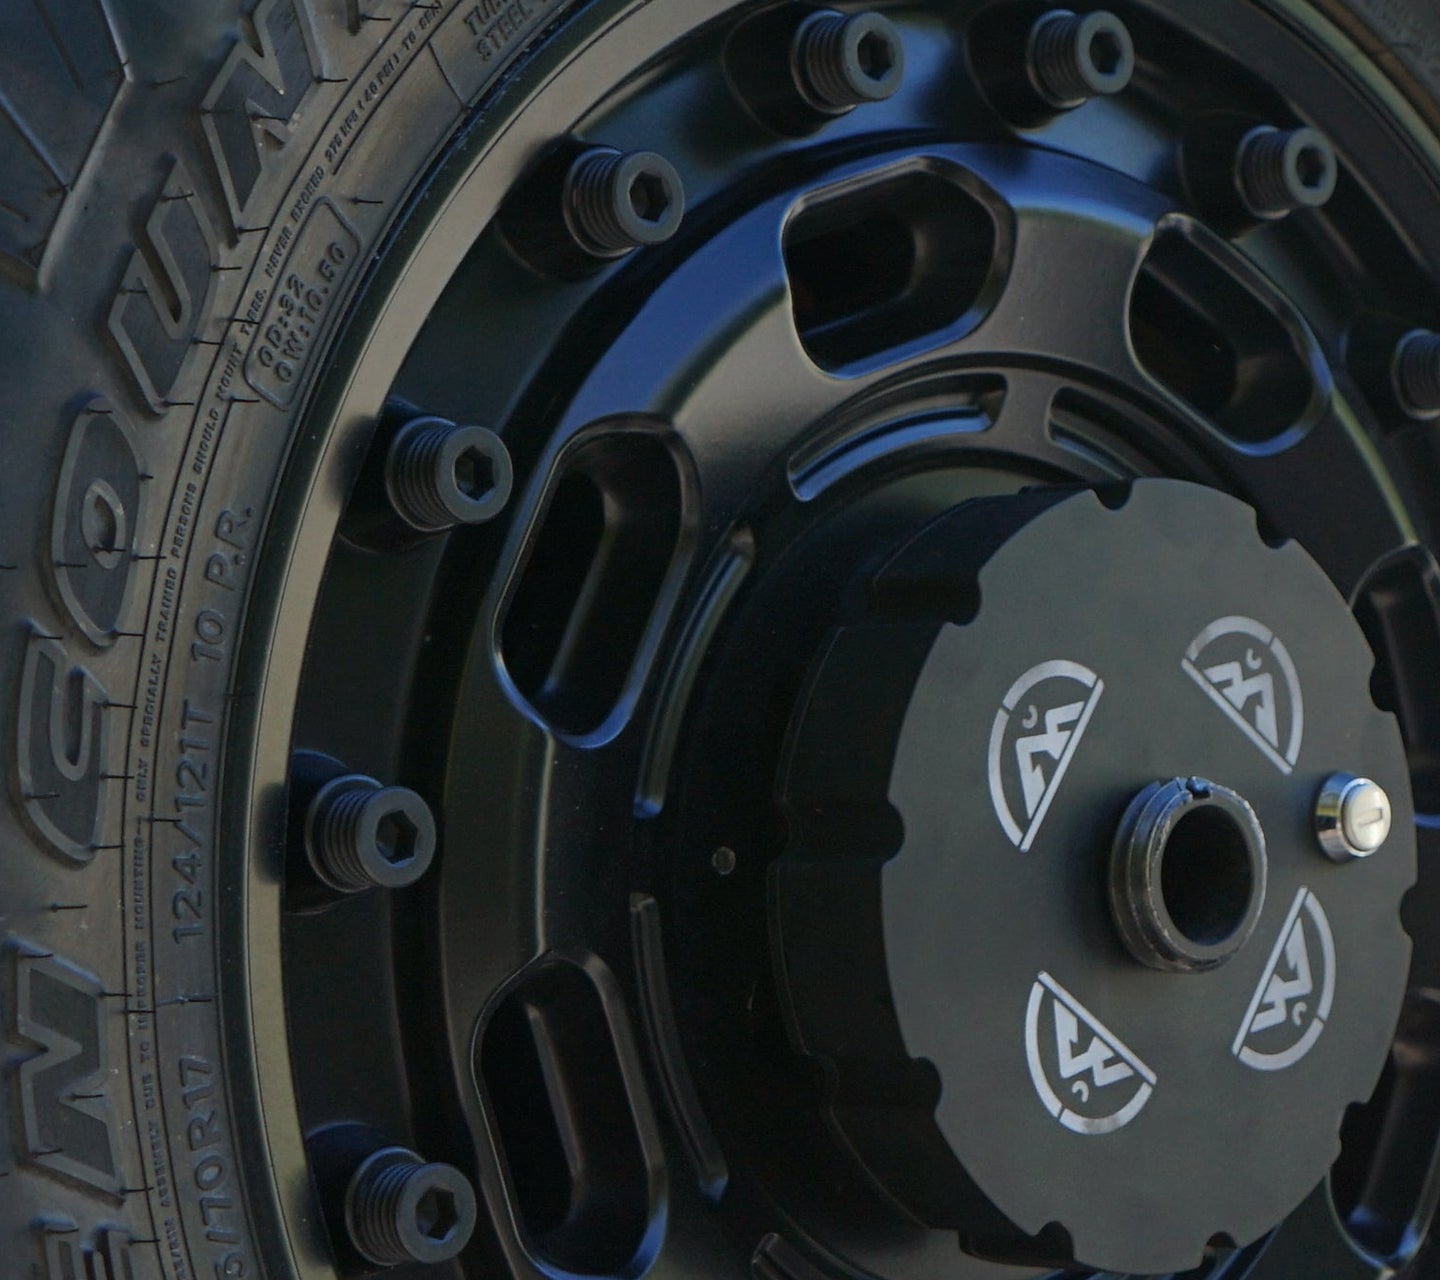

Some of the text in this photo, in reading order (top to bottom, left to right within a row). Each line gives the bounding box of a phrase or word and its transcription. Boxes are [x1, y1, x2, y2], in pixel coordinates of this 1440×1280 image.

[398, 28, 419, 51] TO
[288, 165, 327, 223] EXCEED
[261, 225, 295, 278] NEVER
[252, 271, 308, 369] OD:32
[269, 238, 350, 385] OW:10.50
[214, 341, 245, 400] MOUNT
[190, 407, 222, 475] SHOULD
[168, 481, 199, 559] PERSONS
[200, 498, 256, 592] P.R.
[153, 567, 179, 643] TRAINED
[187, 606, 230, 666] 10
[139, 652, 163, 747] SPECIALLY
[135, 757, 150, 802] ONLY
[168, 698, 216, 945] 124/121T
[134, 940, 149, 1031] IMPROPER
[138, 1040, 151, 1064] TO
[141, 1073, 156, 1110] DUE
[147, 1119, 171, 1209] ASSEMBLY
